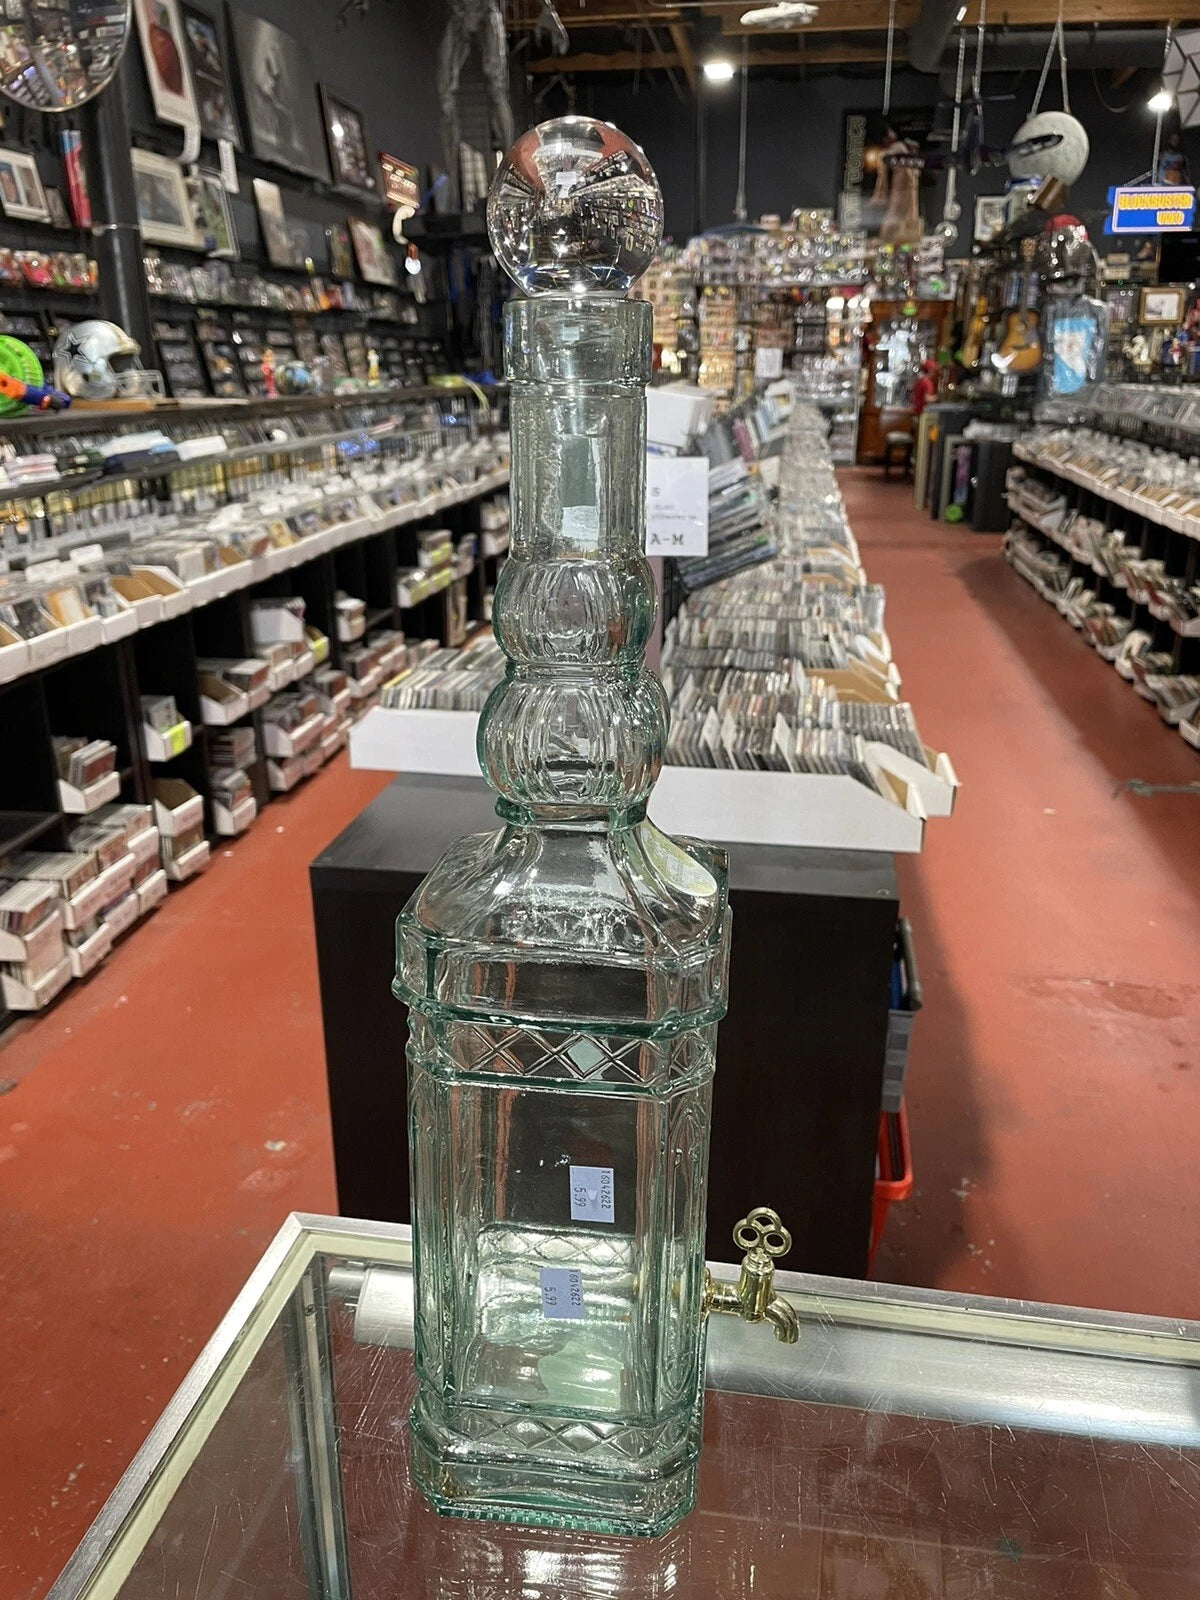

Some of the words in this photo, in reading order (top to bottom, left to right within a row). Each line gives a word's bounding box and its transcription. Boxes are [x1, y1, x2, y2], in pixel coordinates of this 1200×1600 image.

[574, 1186, 587, 1208] 5.99
[600, 1169, 612, 1209] 16042622
[544, 1286, 557, 1306] 5.99
[569, 1269, 581, 1306] 16042622
